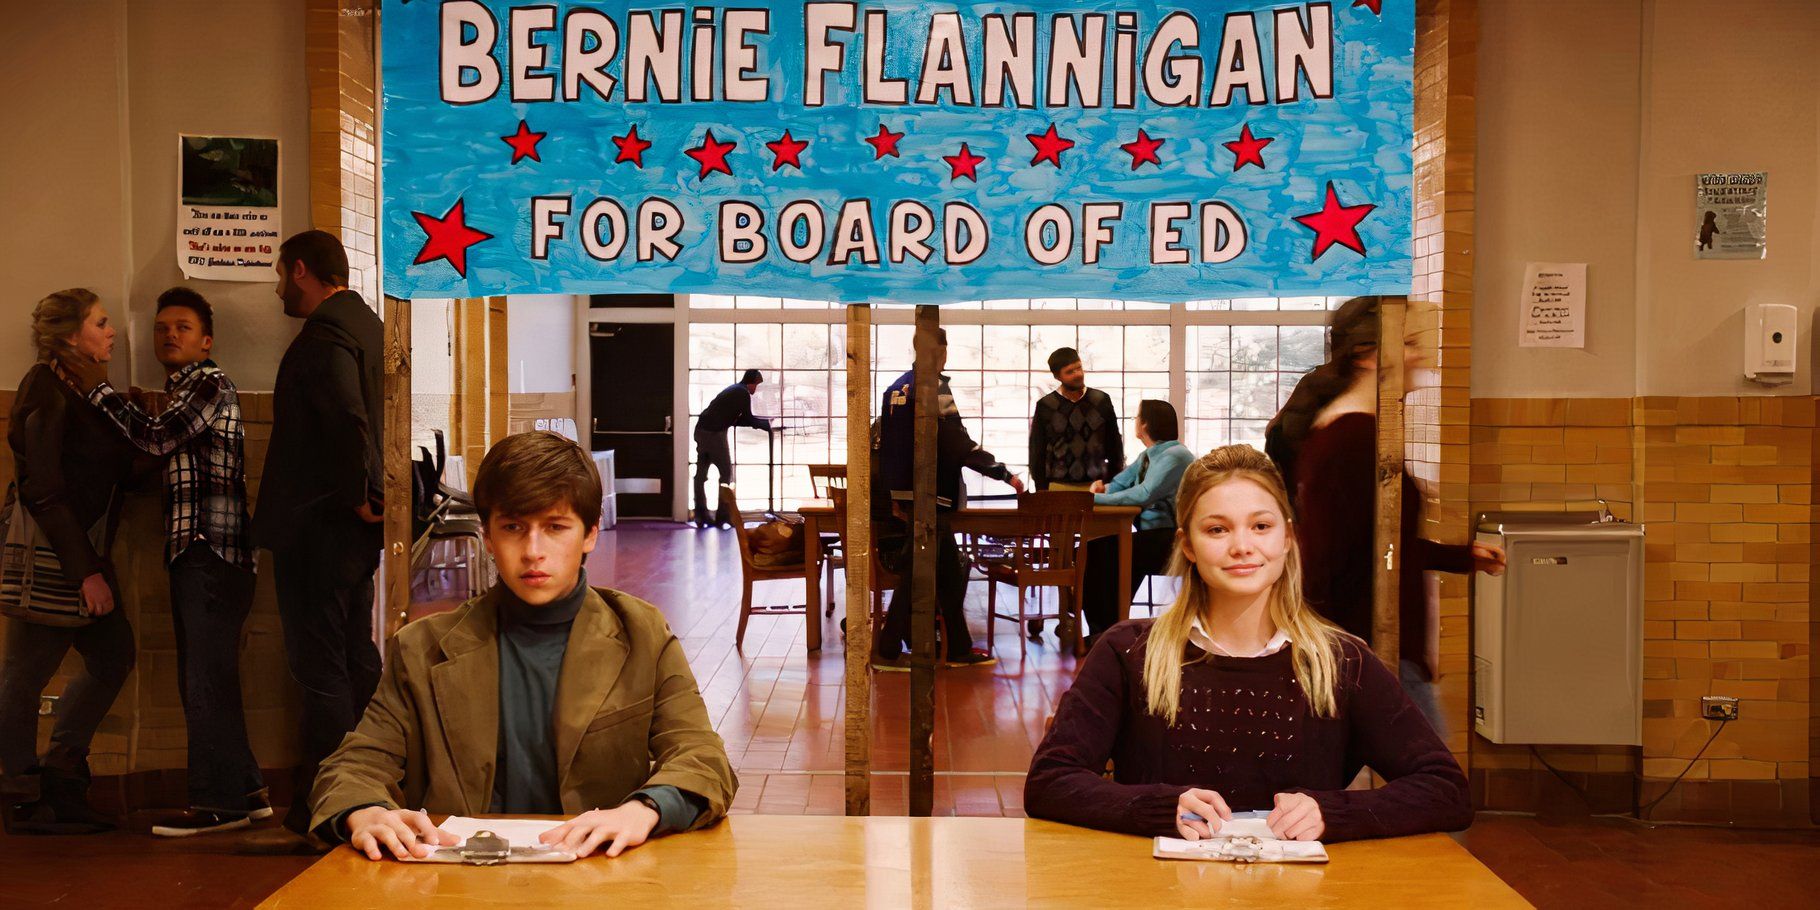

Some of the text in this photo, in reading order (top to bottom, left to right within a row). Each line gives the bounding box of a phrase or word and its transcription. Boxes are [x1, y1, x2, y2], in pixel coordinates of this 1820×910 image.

[530, 196, 1248, 267] FOR BOARD OF ED
